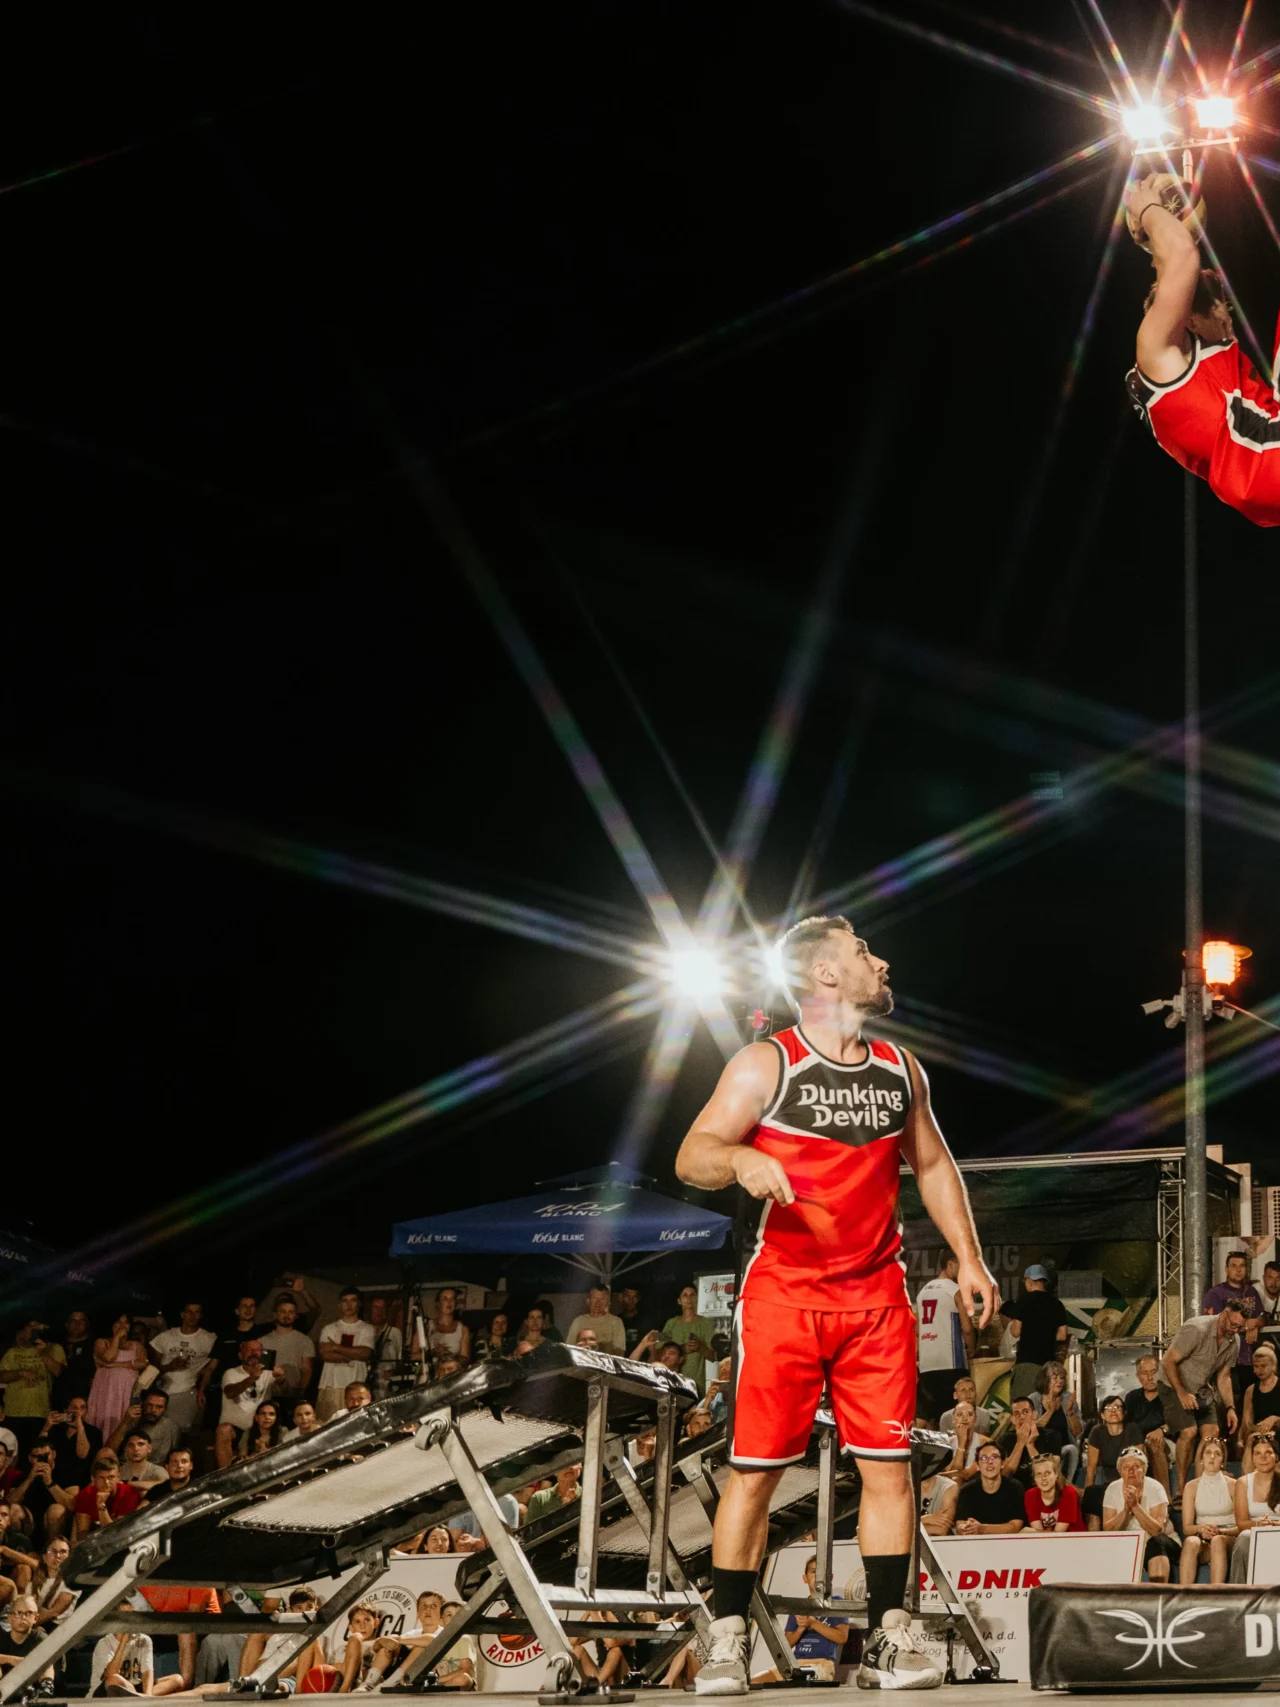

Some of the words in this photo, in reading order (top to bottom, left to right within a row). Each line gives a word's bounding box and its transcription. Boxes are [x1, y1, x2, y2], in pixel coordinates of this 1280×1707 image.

[797, 1083, 904, 1112] Dunking
[811, 1104, 891, 1131] Devils
[921, 1298, 938, 1325] 17
[486, 1642, 544, 1664] RADNIK
